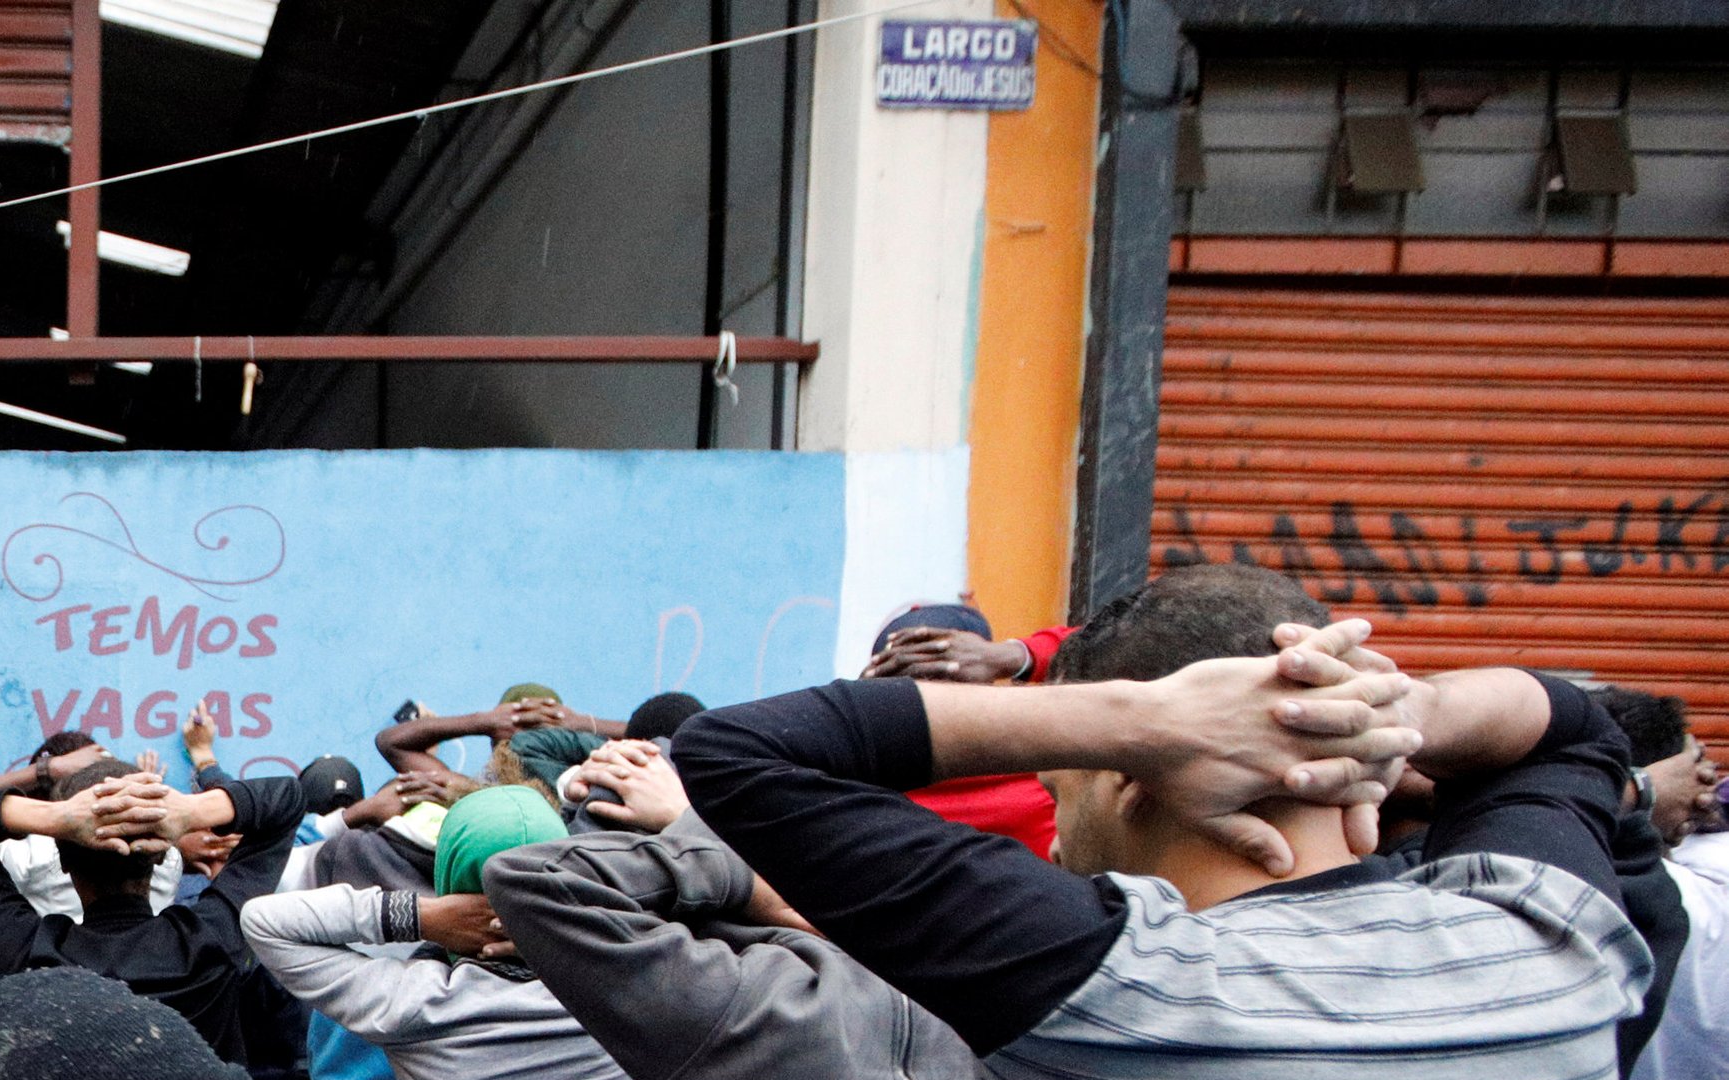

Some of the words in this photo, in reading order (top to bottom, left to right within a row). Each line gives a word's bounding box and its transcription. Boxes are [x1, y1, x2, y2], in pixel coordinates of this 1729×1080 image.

[903, 26, 1016, 61] LARGO
[878, 61, 961, 101] CORAÇÃO
[977, 64, 1035, 100] JESUS
[35, 595, 278, 669] TEMOS
[31, 687, 272, 739] VAGAS
